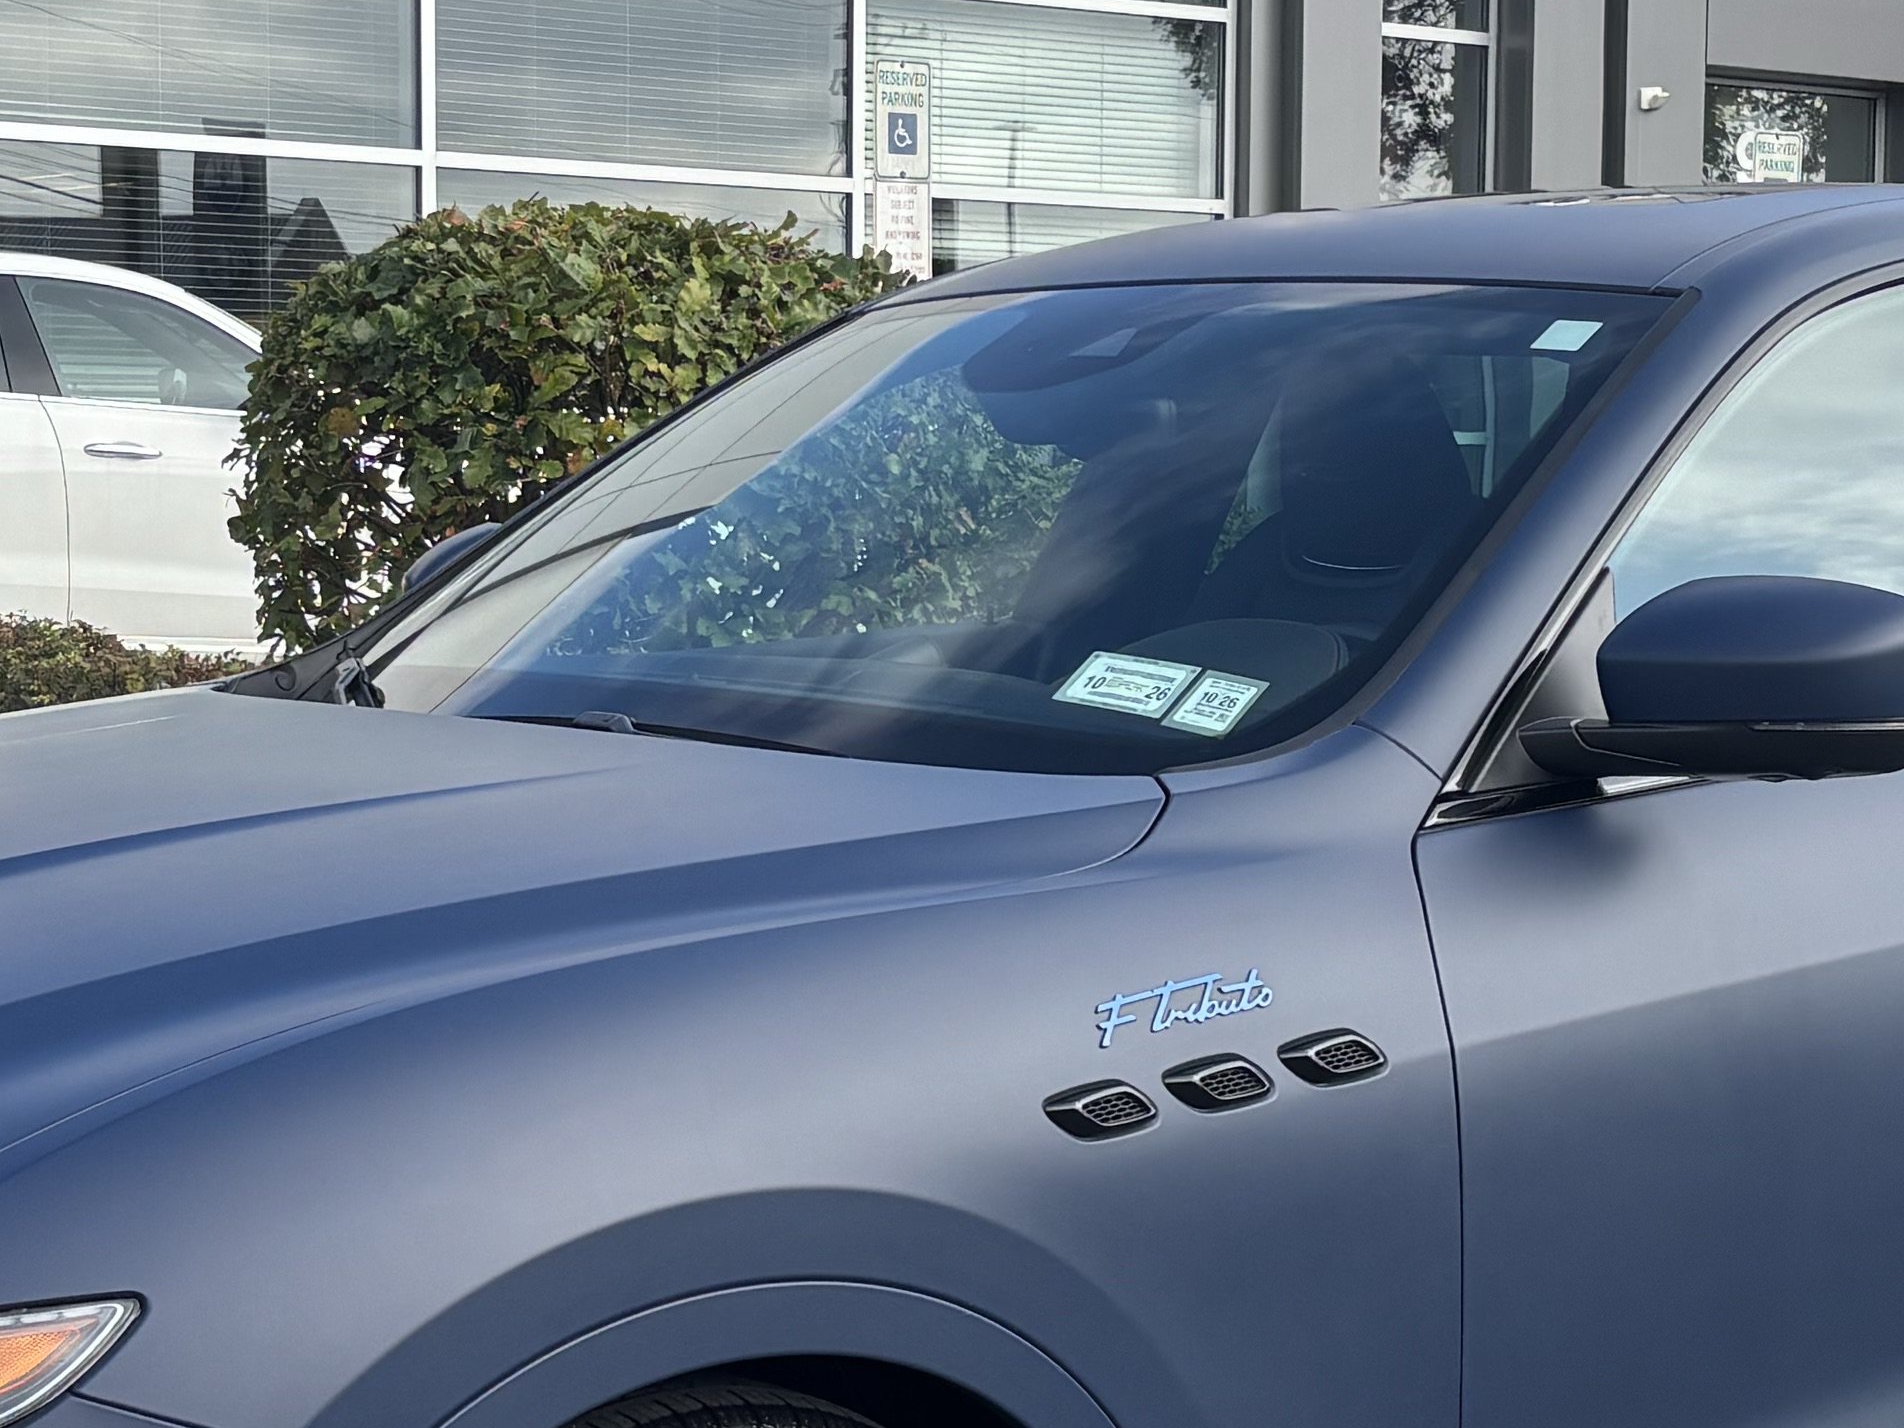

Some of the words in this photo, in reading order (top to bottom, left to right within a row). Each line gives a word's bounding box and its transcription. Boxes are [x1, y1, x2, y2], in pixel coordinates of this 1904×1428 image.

[878, 70, 927, 87] RESERVED
[881, 90, 924, 108] PARKING
[1083, 675, 1107, 690] 10
[1144, 686, 1171, 702] 26
[1199, 690, 1218, 704] 10
[1218, 694, 1240, 709] 26
[1150, 968, 1274, 1033] Tributo
